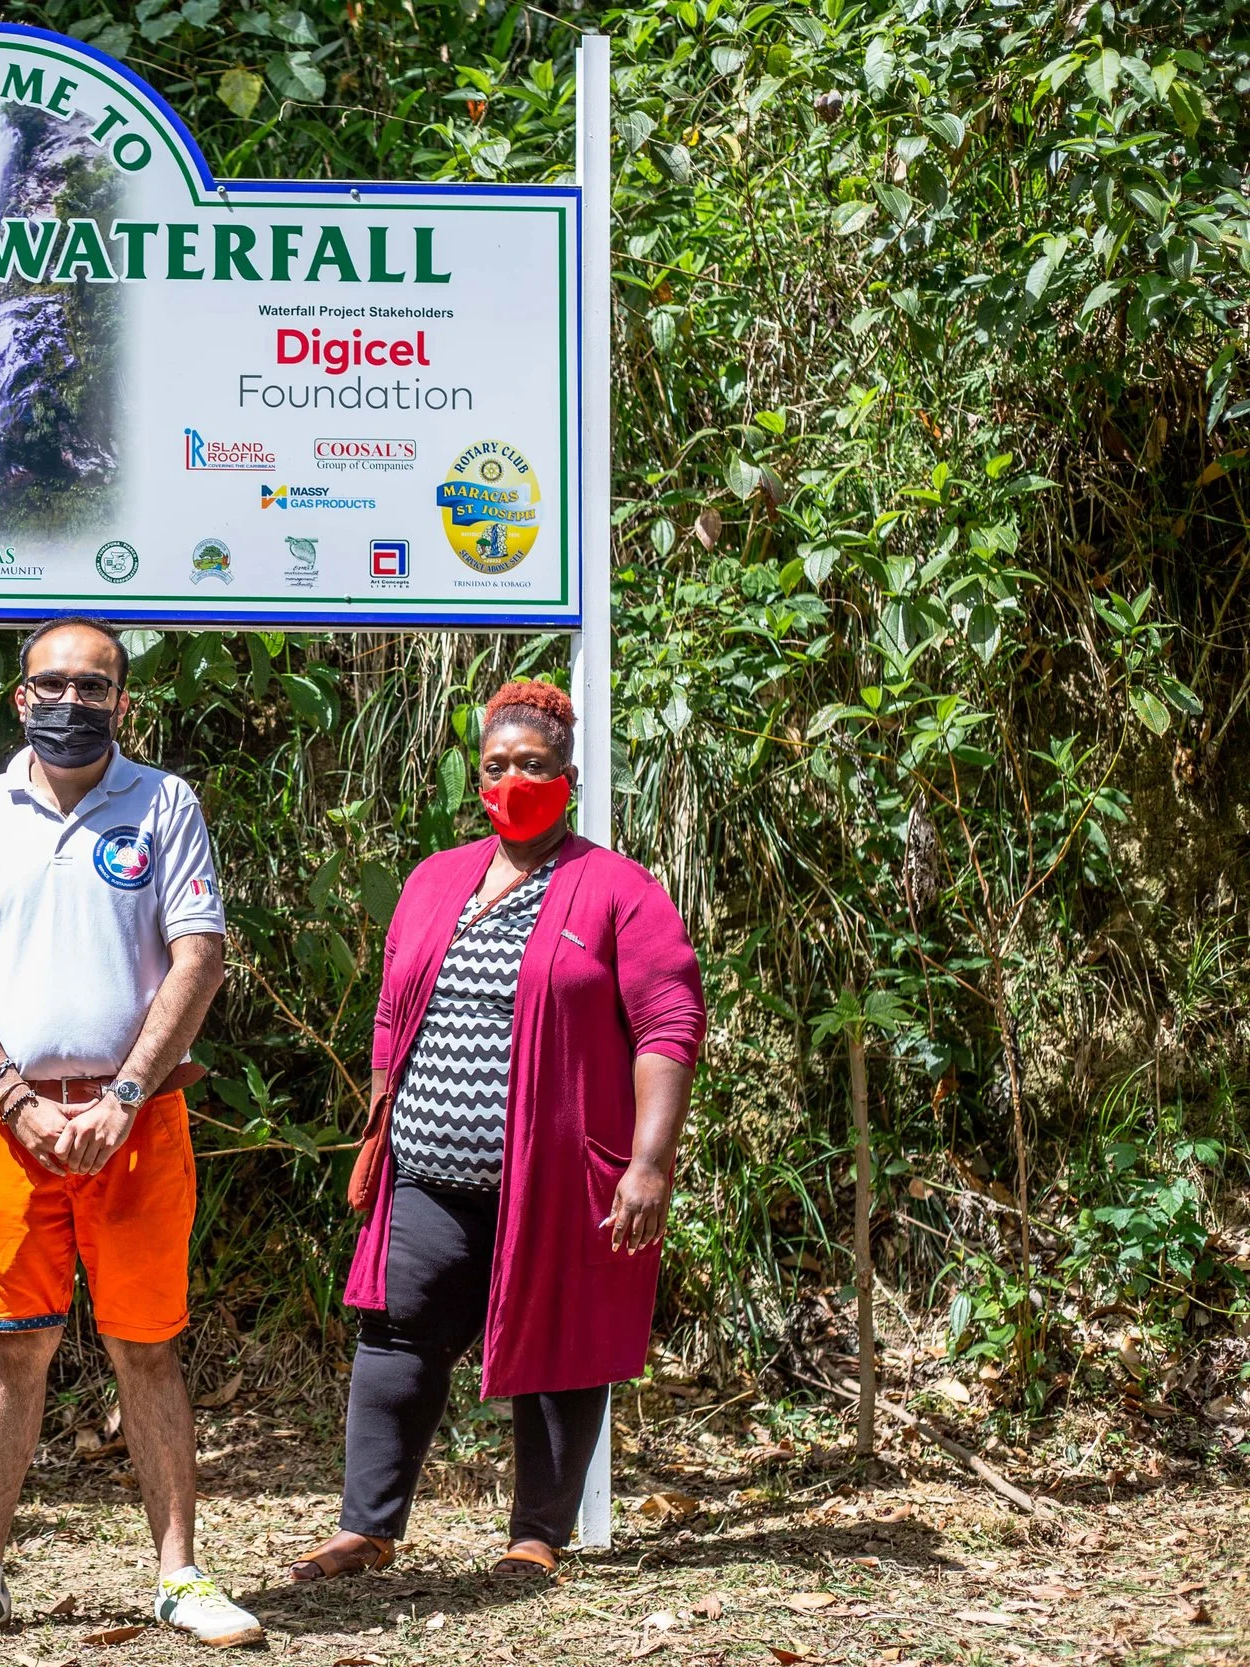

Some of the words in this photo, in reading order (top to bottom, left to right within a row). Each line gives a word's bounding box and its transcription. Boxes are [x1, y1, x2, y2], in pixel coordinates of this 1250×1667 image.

[90, 104, 152, 172] TO
[258, 304, 315, 317] Waterfall
[319, 305, 365, 319] Project
[369, 306, 454, 319] Stakeholders
[277, 328, 431, 376] Digicel
[239, 374, 473, 411] Foundation
[207, 442, 263, 453] ISLAND
[207, 452, 276, 463] ROOFING
[454, 442, 499, 474] ROTARY
[501, 446, 529, 474] CLUB
[316, 460, 347, 472] Group
[349, 460, 362, 470] of
[362, 461, 414, 472] Companies
[290, 487, 330, 497] MASSY
[443, 485, 519, 504] MARACAS
[290, 499, 314, 509] GAS
[315, 499, 376, 509] PRODUCTS
[456, 504, 477, 516] ST.
[482, 504, 536, 522] JOSEPH
[454, 580, 491, 588] TRINIDAD
